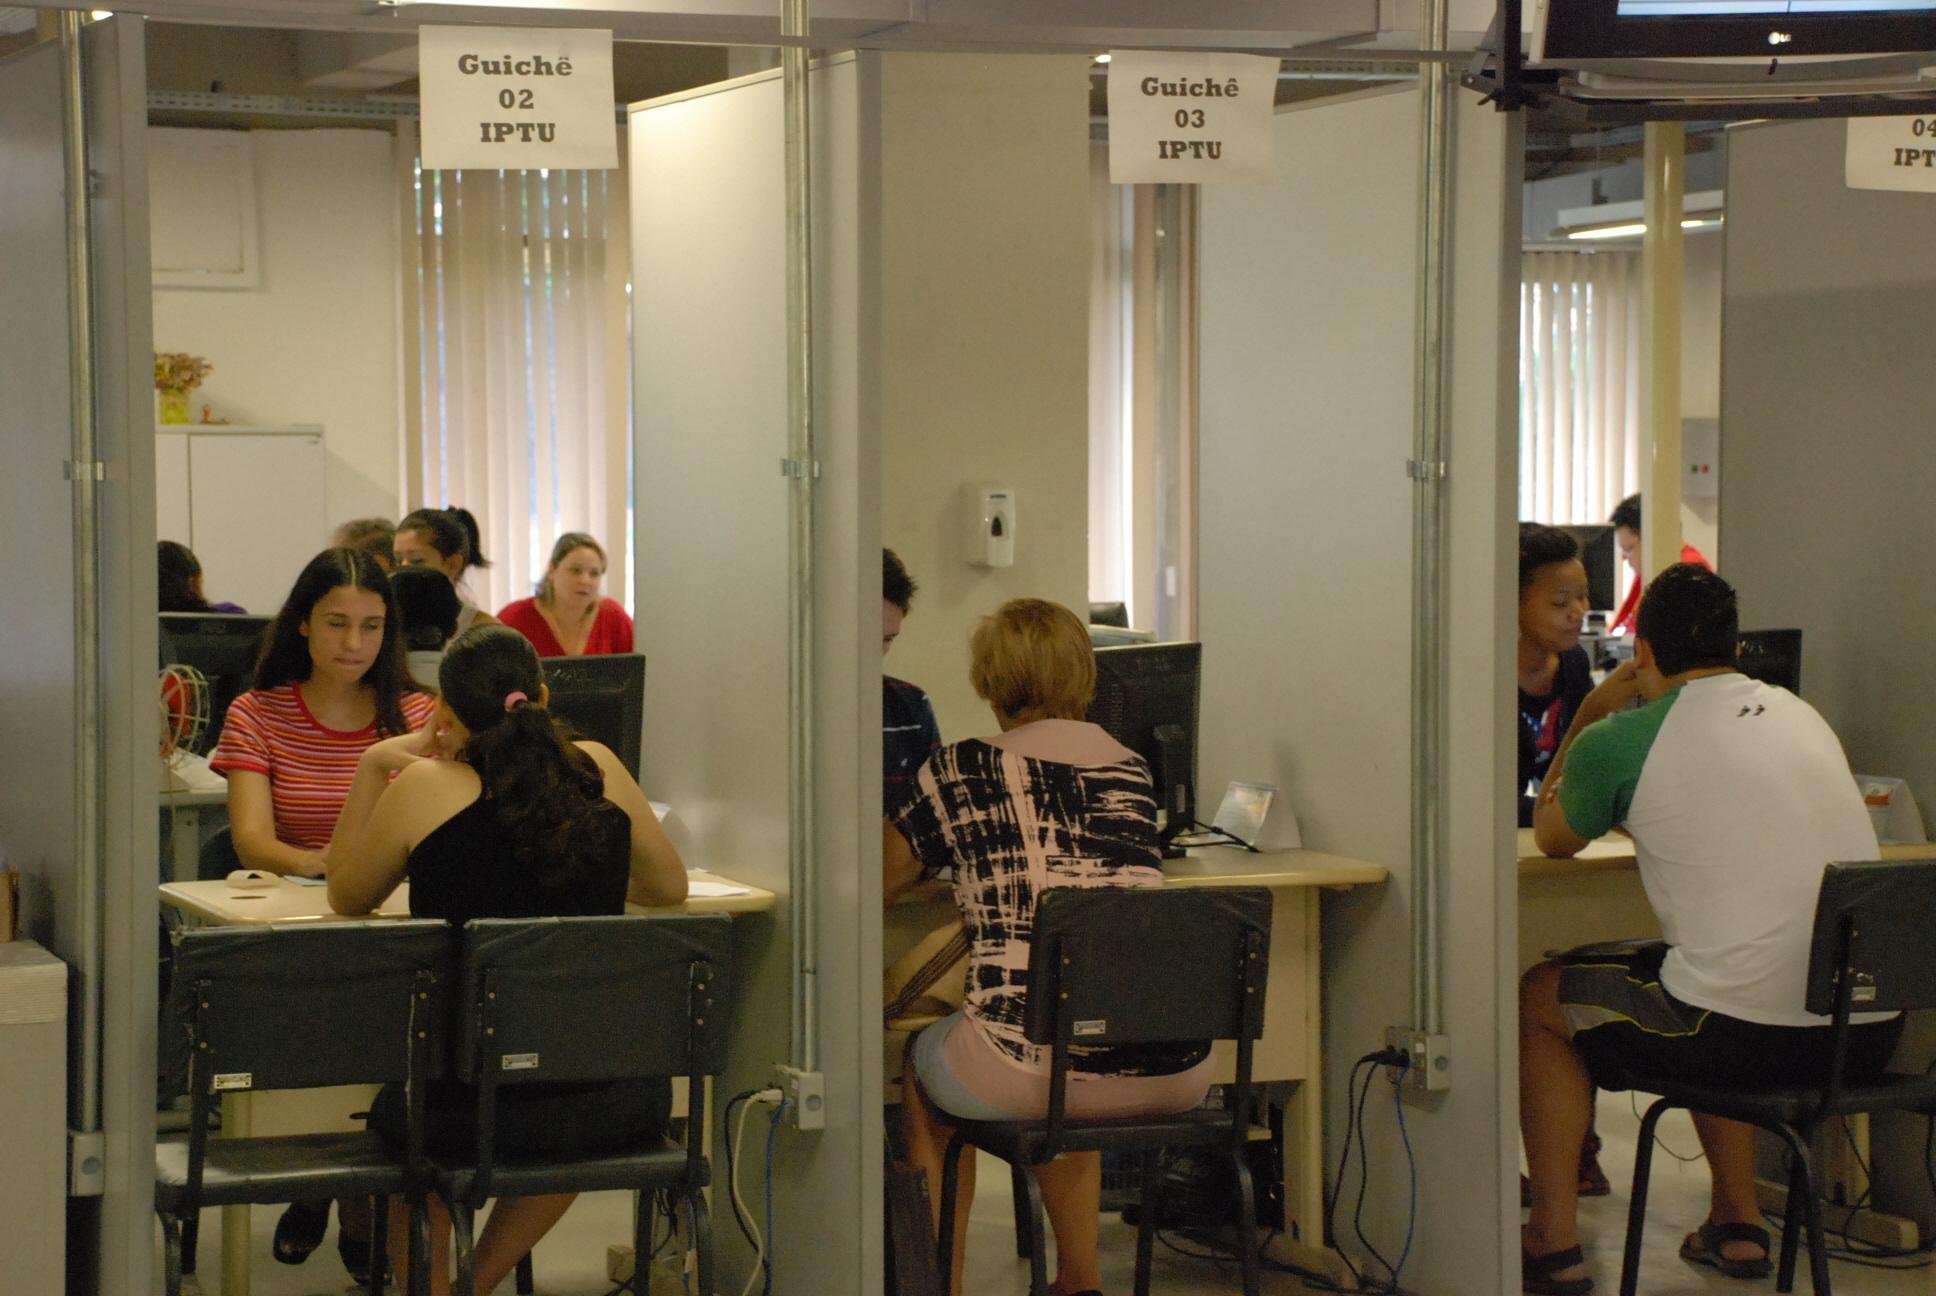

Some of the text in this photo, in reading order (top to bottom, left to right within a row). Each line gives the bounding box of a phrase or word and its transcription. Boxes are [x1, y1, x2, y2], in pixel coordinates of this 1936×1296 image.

[457, 54, 573, 76] Guichê
[1140, 76, 1240, 98] Guichê
[498, 88, 535, 110] 02
[1174, 109, 1206, 129] 03
[480, 122, 556, 143] IPTU
[1157, 140, 1222, 160] IPTU
